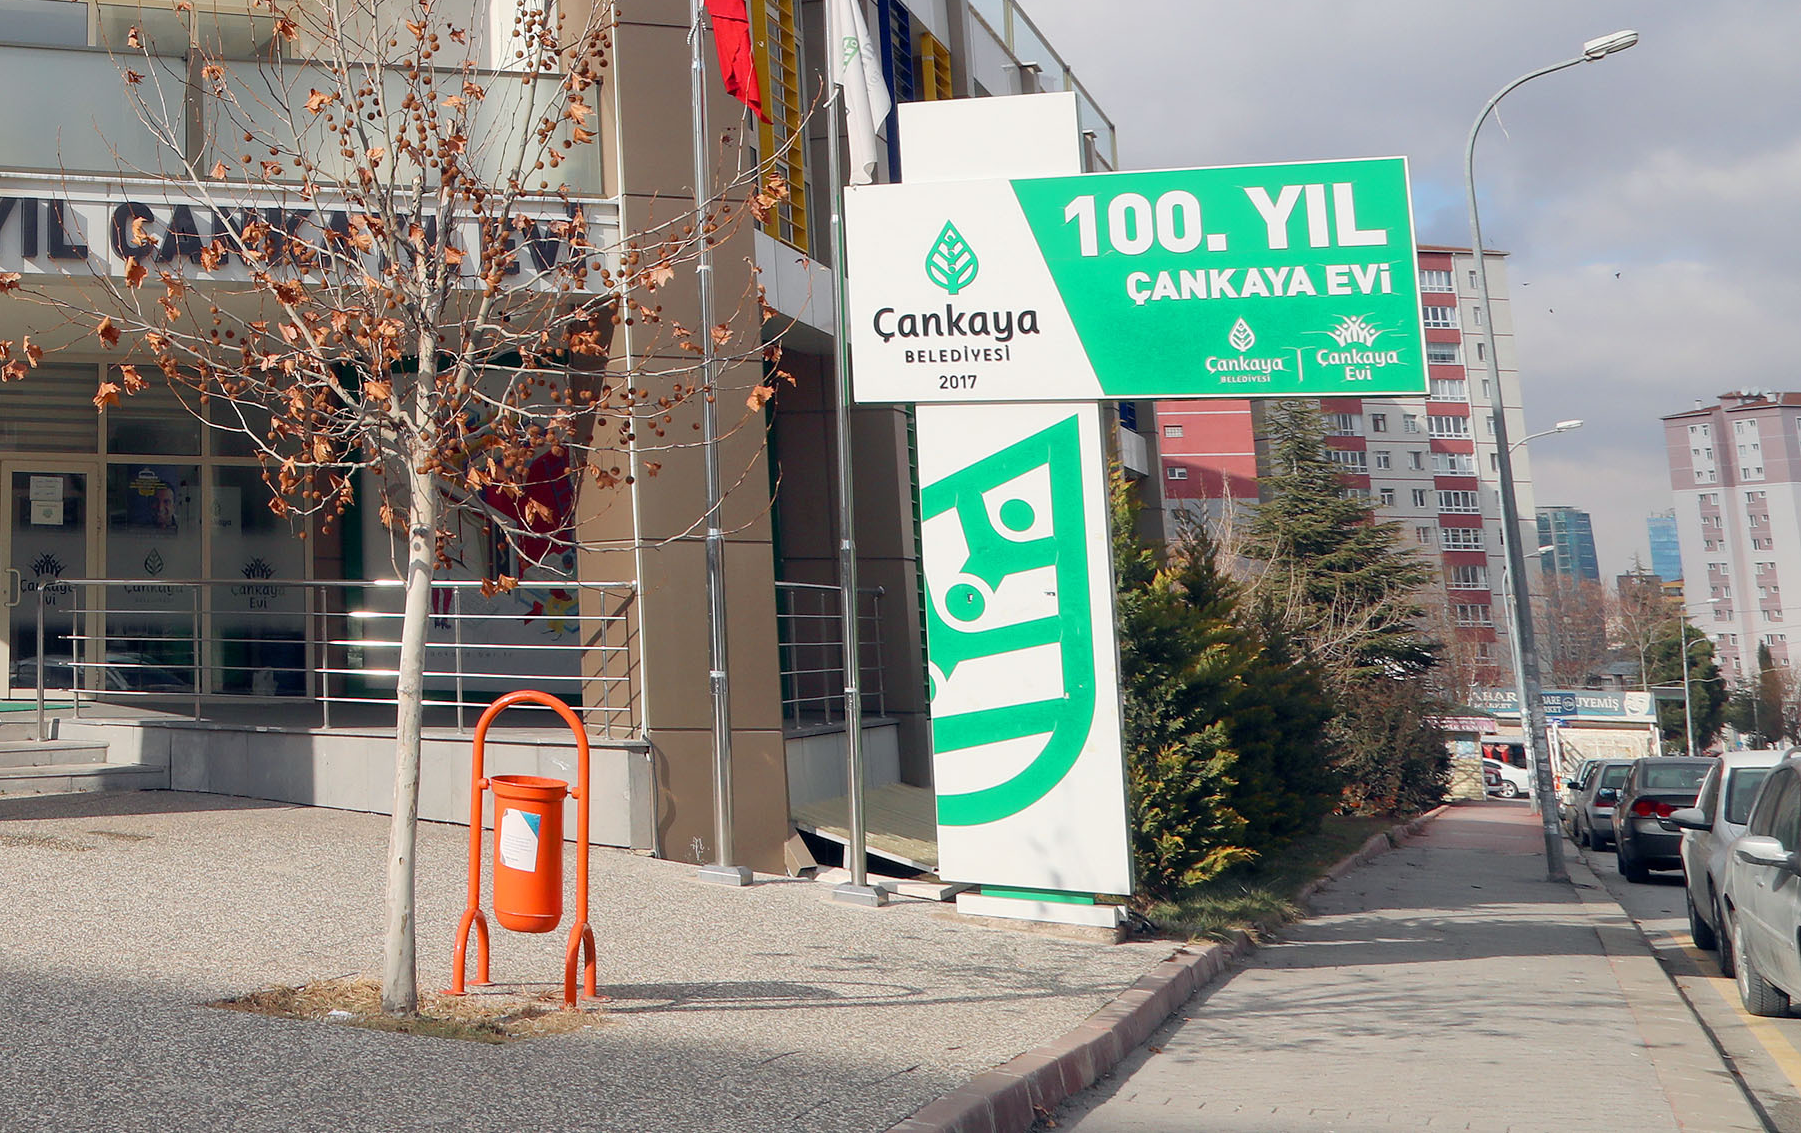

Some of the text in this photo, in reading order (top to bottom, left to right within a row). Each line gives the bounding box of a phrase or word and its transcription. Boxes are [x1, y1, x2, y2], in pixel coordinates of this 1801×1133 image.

[1064, 182, 1388, 257] 100. YIL
[1126, 263, 1392, 305] ÇANKAYA EVİ
[873, 303, 1040, 343] Çankaya
[905, 344, 1010, 363] BELEDİYESİ
[1316, 348, 1398, 368] Çankaya
[1205, 355, 1284, 375] Çankaya
[1345, 365, 1372, 381] Evi
[939, 374, 977, 389] 2017
